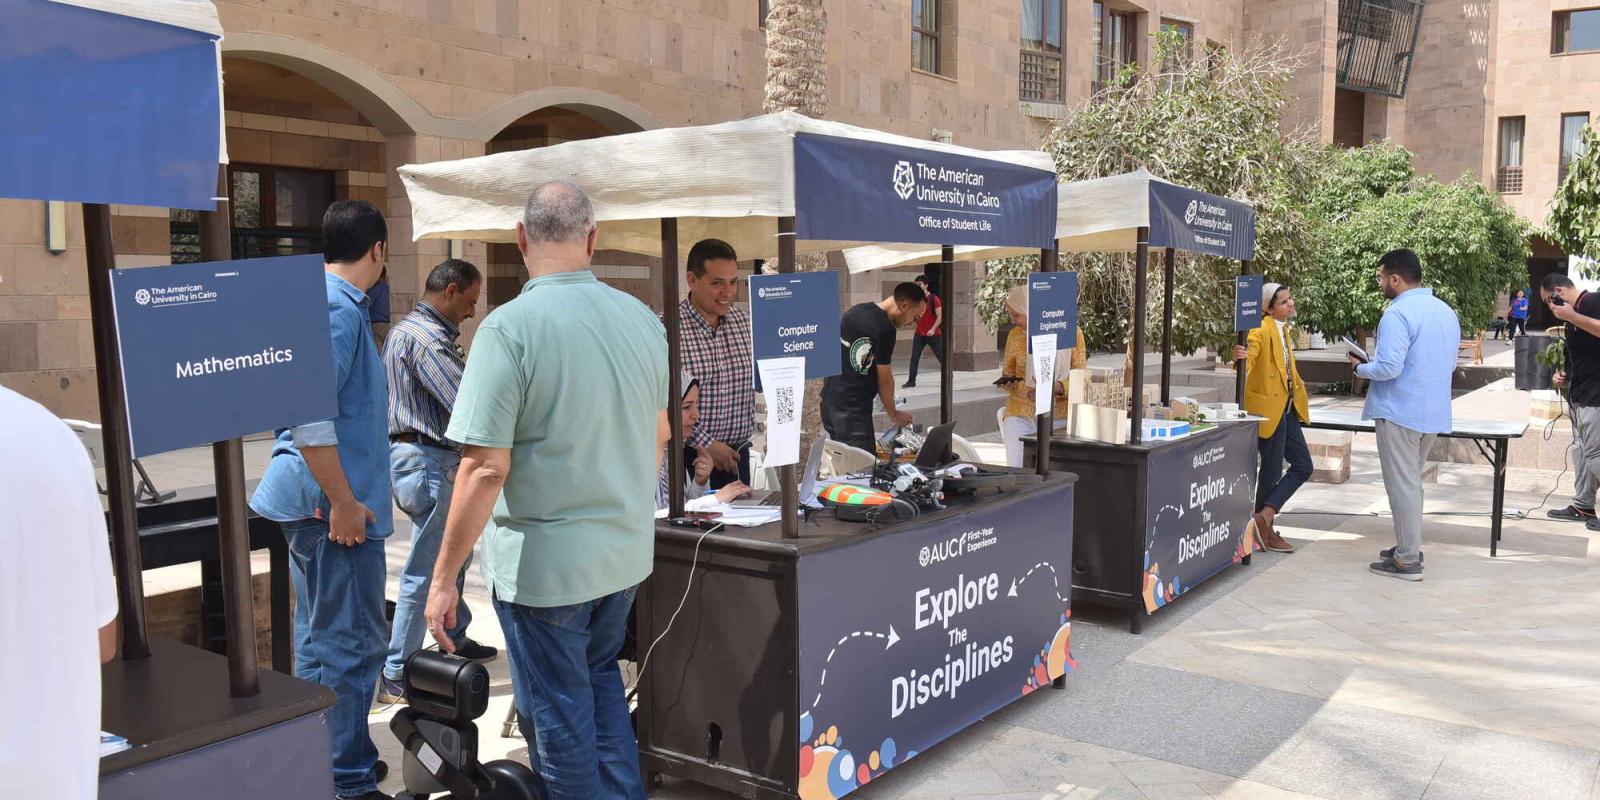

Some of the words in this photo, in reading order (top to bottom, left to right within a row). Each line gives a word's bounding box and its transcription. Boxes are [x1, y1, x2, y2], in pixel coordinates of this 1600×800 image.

[916, 163, 936, 180] The
[938, 166, 984, 186] American
[916, 185, 966, 207] University
[967, 189, 975, 205] in
[976, 192, 1000, 208] Cairo
[1199, 201, 1207, 213] The
[1207, 204, 1226, 216] American
[919, 216, 941, 228] Office
[942, 217, 950, 228] of
[951, 218, 978, 230] Student
[979, 220, 992, 231] Life
[1194, 216, 1216, 230] University
[1217, 218, 1222, 229] in
[1222, 220, 1232, 231] Cairo
[151, 287, 165, 295] The
[167, 284, 202, 294] American
[151, 294, 189, 304] University
[198, 291, 217, 300] Cairo
[1042, 309, 1065, 319] Computer
[778, 323, 818, 337] Computer
[1040, 321, 1066, 331] Engineering
[784, 341, 814, 353] Science
[176, 347, 293, 378] Mathematics
[1190, 475, 1225, 511] Explore
[1202, 511, 1211, 523] The
[967, 527, 994, 541] First-Year
[967, 537, 997, 552] Experience
[1178, 521, 1230, 564] Disciplines
[915, 572, 999, 630] Explore
[948, 627, 968, 647] The
[891, 635, 1013, 719] Disciplines
